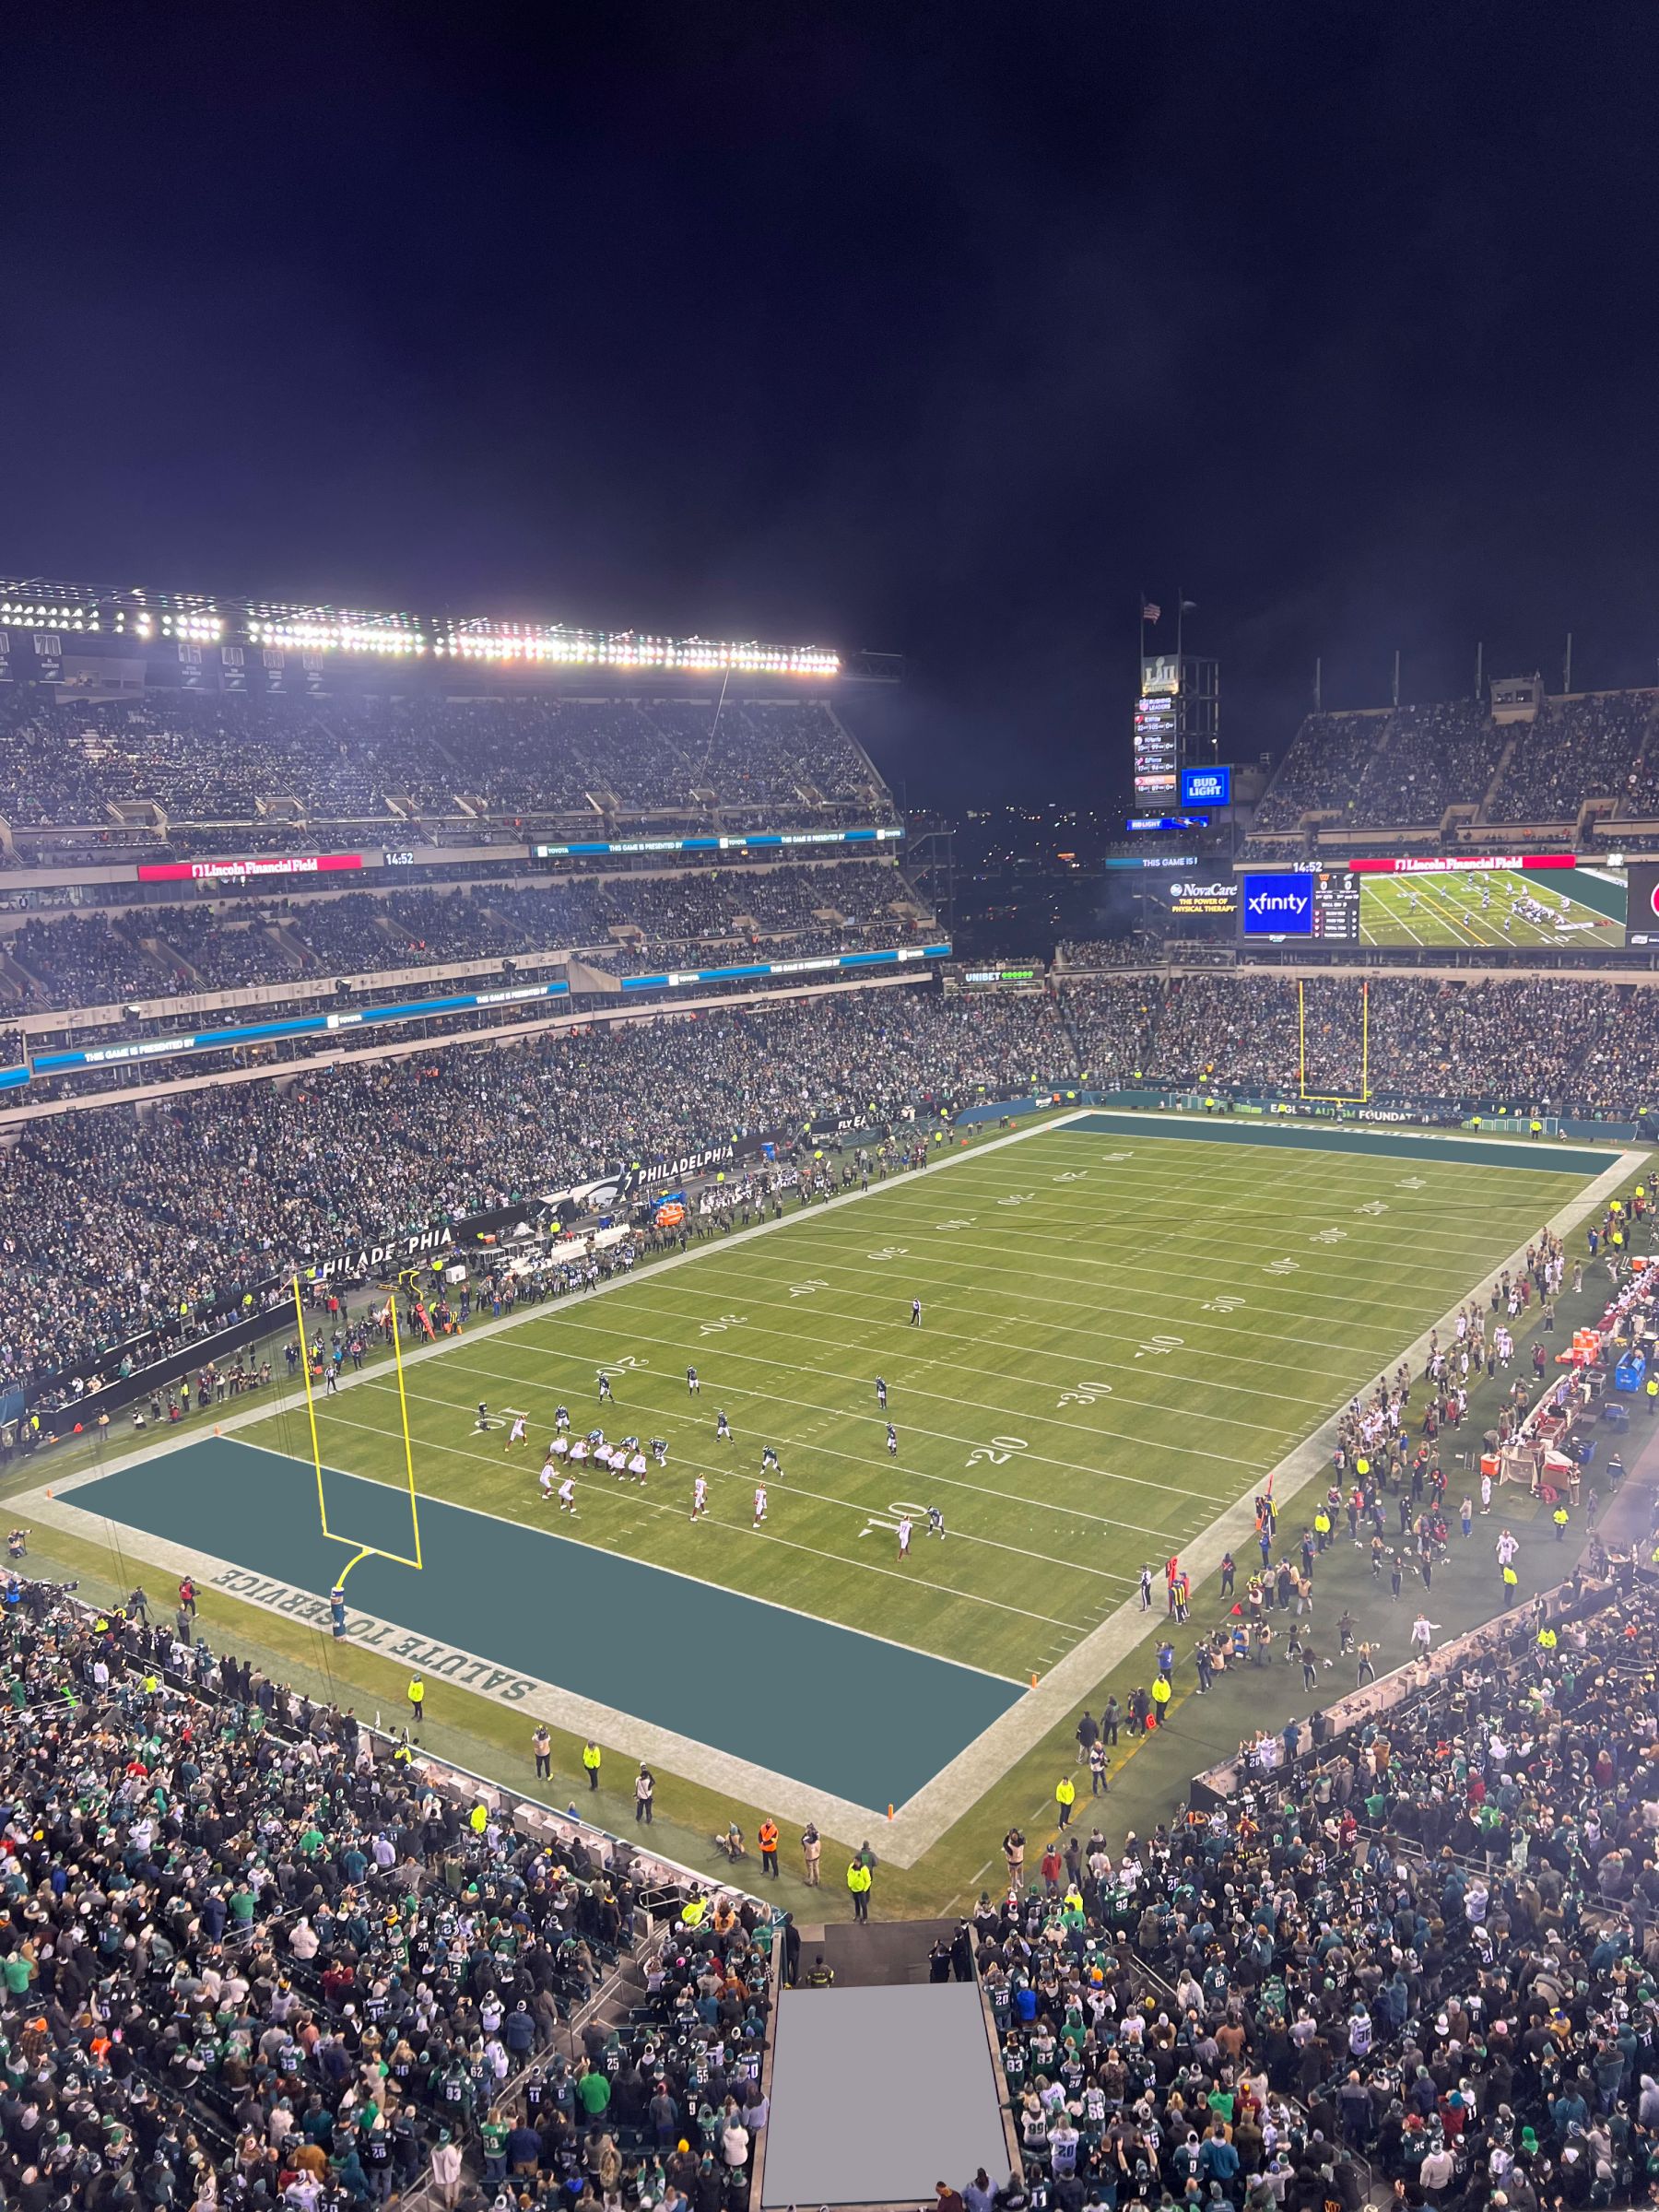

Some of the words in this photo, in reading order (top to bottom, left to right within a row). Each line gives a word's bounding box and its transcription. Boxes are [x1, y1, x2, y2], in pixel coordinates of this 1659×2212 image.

[1193, 777, 1218, 787] BUD
[1189, 785, 1221, 796] LIGHT
[793, 834, 806, 842] GAME
[385, 853, 414, 865] 14:52
[1161, 858, 1184, 866] GAME
[1406, 858, 1446, 870] Lincoln
[1446, 857, 1493, 869] Financial
[1494, 857, 1523, 868] Field
[205, 863, 245, 877] Lincoln
[245, 859, 292, 875] Financial
[292, 858, 317, 871] Field
[1292, 862, 1323, 873] 14:52
[1182, 883, 1238, 896] NovaCare
[1320, 881, 1327, 890] 0
[1344, 880, 1352, 890] 0
[1249, 892, 1308, 914] xfinity
[966, 972, 1001, 982] UNIBET
[477, 995, 488, 1004] THIS
[489, 993, 504, 1002] GAME
[540, 986, 547, 994] BY
[339, 1014, 362, 1024] TOYOTA
[85, 1053, 104, 1062] THIS
[105, 1049, 129, 1060] GAME
[130, 1047, 137, 1055] IS
[139, 1041, 182, 1054] PRESENTED
[183, 1038, 194, 1048] BY
[838, 1119, 853, 1130] FLY
[639, 1146, 735, 1185] PHILADELPHIA
[1394, 1179, 1427, 1189] 10
[1353, 1203, 1390, 1215] 20
[1309, 1230, 1347, 1243] 30
[312, 1228, 452, 1278] HILADEPHIA
[866, 1246, 910, 1260] 50
[1261, 1260, 1300, 1276] 40
[789, 1278, 830, 1294] 40
[1200, 1296, 1246, 1313] 50
[700, 1314, 748, 1332] 30
[1139, 1335, 1185, 1356] 40
[595, 1356, 651, 1377] 20
[1061, 1382, 1113, 1405] 30
[474, 1406, 532, 1430] 10
[971, 1436, 1029, 1465] 20
[866, 1501, 929, 1534] 10
[210, 1570, 348, 1627] SERVICE
[346, 1618, 397, 1645] TO
[387, 1637, 538, 1701] SALUTE
[390, 1831, 398, 1841] 11
[1346, 1830, 1357, 1842] 92
[1115, 1898, 1129, 1912] 92
[418, 1942, 429, 1952] 20
[1482, 1952, 1493, 1963] 21
[449, 1964, 462, 1976] 12
[1215, 1975, 1226, 1988] 62
[995, 1994, 1009, 2006] 20
[1473, 2010, 1479, 2020] 6
[1643, 2033, 1653, 2045] 11
[606, 2058, 619, 2071] 25
[1037, 2053, 1053, 2065] 83
[1091, 2054, 1097, 2068] 1
[471, 2066, 484, 2078] 62
[1006, 2059, 1023, 2073] 83
[697, 2070, 709, 2084] 55
[1392, 2080, 1400, 2093] 17
[445, 2087, 462, 2101] 93
[528, 2092, 540, 2103] 11
[558, 2088, 565, 2100] 6
[688, 2101, 696, 2116] 9
[1088, 2105, 1105, 2120] 66
[1028, 2122, 1044, 2135] 99
[704, 2131, 715, 2142] 11
[1058, 2144, 1075, 2158] 20
[1190, 2159, 1197, 2173] 9
[1031, 2190, 1047, 2208] 11
